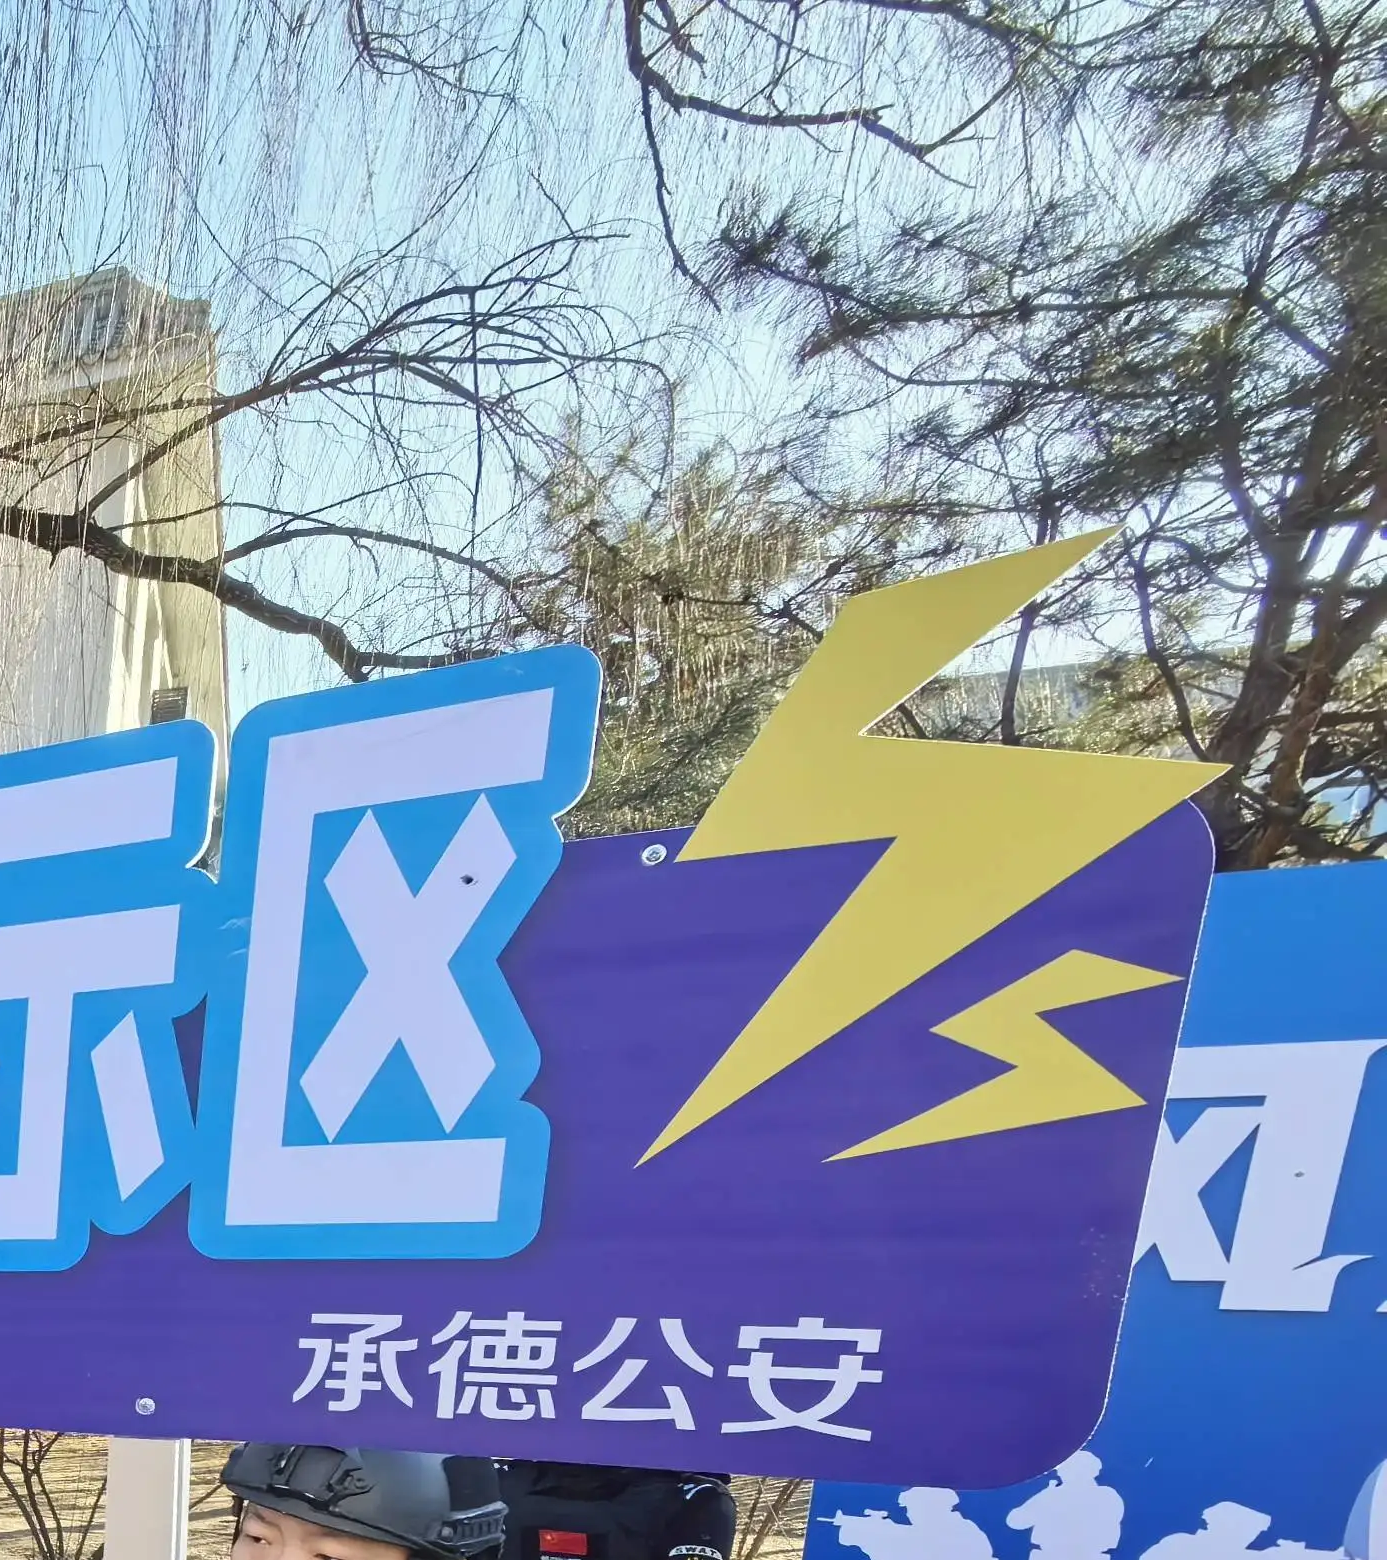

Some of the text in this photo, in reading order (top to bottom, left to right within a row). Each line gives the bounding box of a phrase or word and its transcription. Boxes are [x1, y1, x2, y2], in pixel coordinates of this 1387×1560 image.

[1132, 1038, 1387, 1314] 风
[292, 1310, 884, 1442] 承德公安
